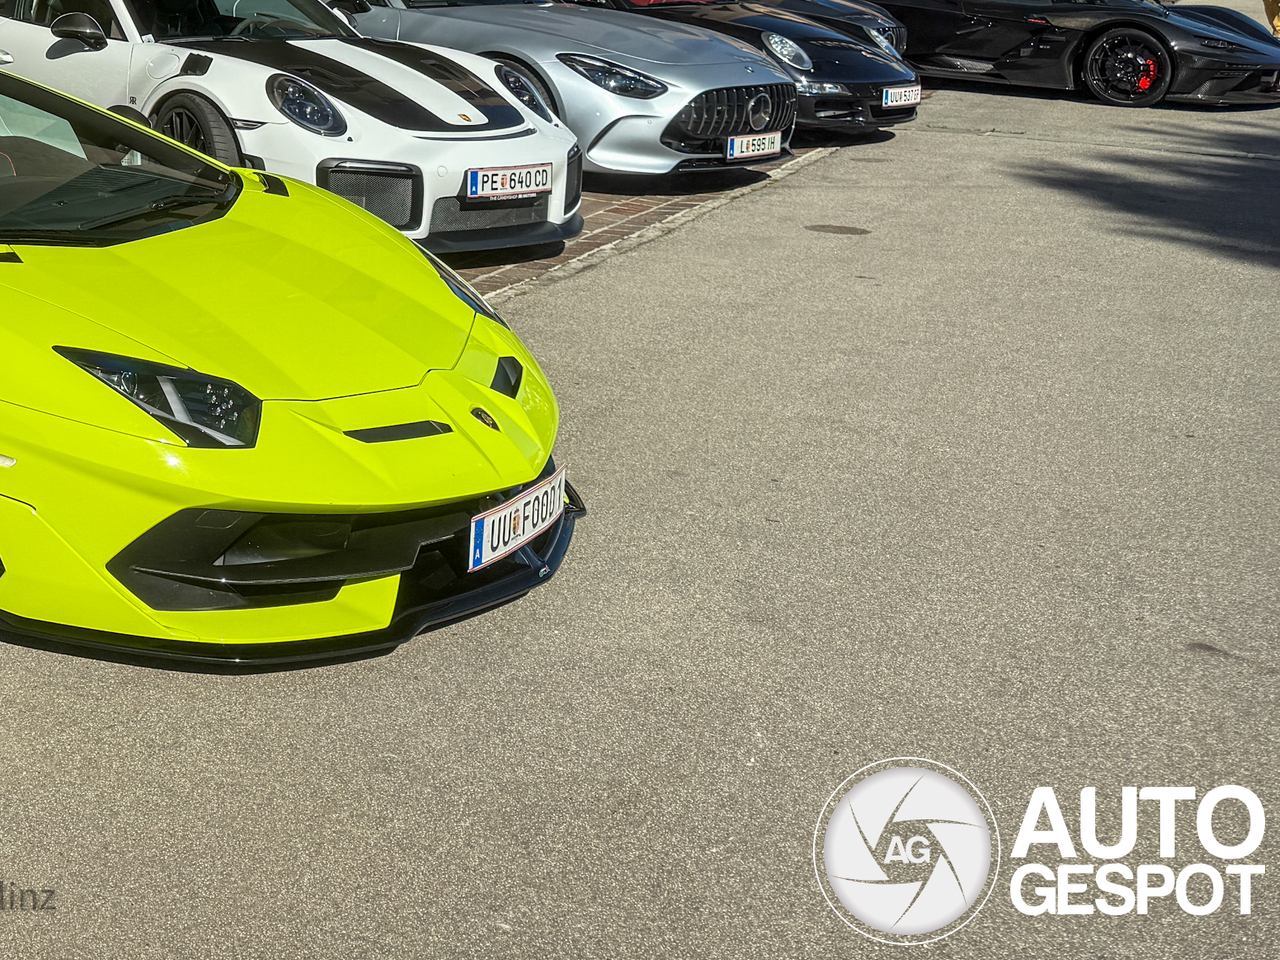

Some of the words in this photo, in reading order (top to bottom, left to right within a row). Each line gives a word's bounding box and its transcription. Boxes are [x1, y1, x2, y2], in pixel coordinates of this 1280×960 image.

[751, 137, 766, 152] 595
[481, 173, 499, 192] PE
[509, 170, 532, 189] 640
[534, 169, 548, 187] CD
[490, 510, 512, 553] UU
